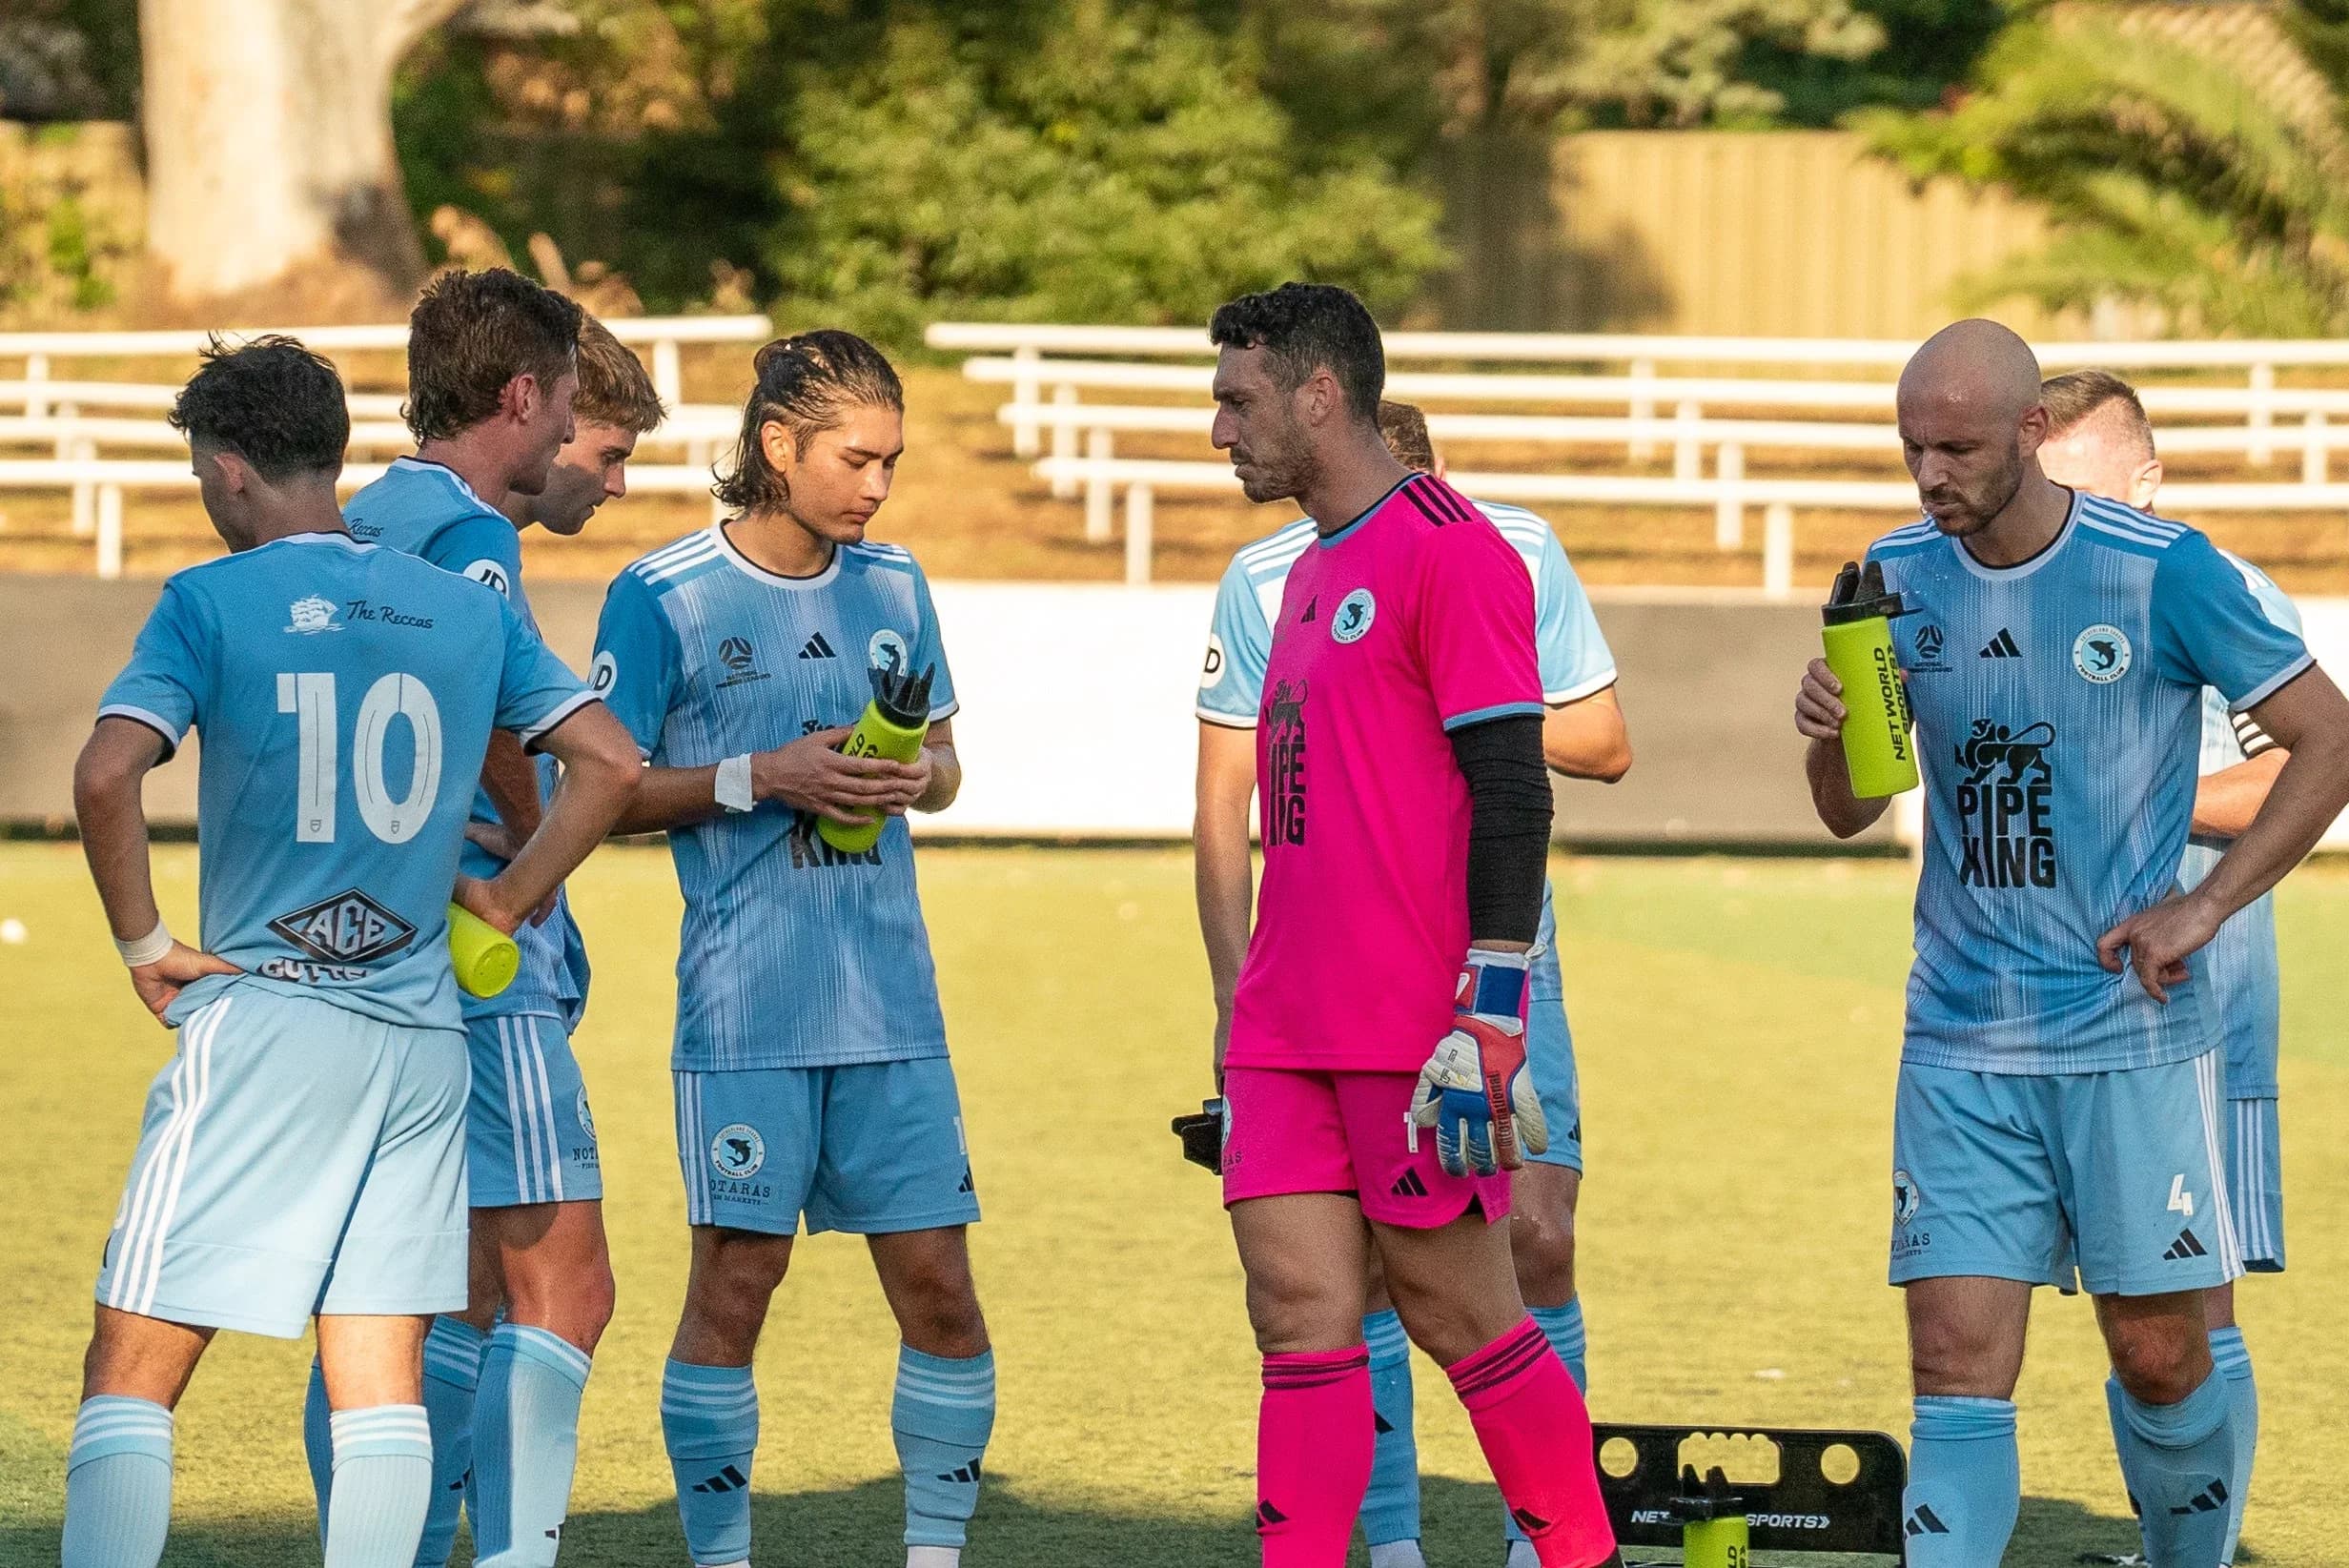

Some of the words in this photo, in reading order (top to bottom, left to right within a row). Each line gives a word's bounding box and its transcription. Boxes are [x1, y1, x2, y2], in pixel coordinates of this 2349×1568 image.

[346, 600, 376, 621] The
[380, 605, 435, 630] Reccas
[1873, 646, 1897, 718] WORLD
[276, 671, 442, 845] 10
[1888, 721, 1907, 762] NET
[1956, 784, 2053, 838] PIPE
[305, 897, 387, 956] ACE
[708, 1179, 771, 1199] OTARAS
[2166, 1173, 2194, 1216] 4
